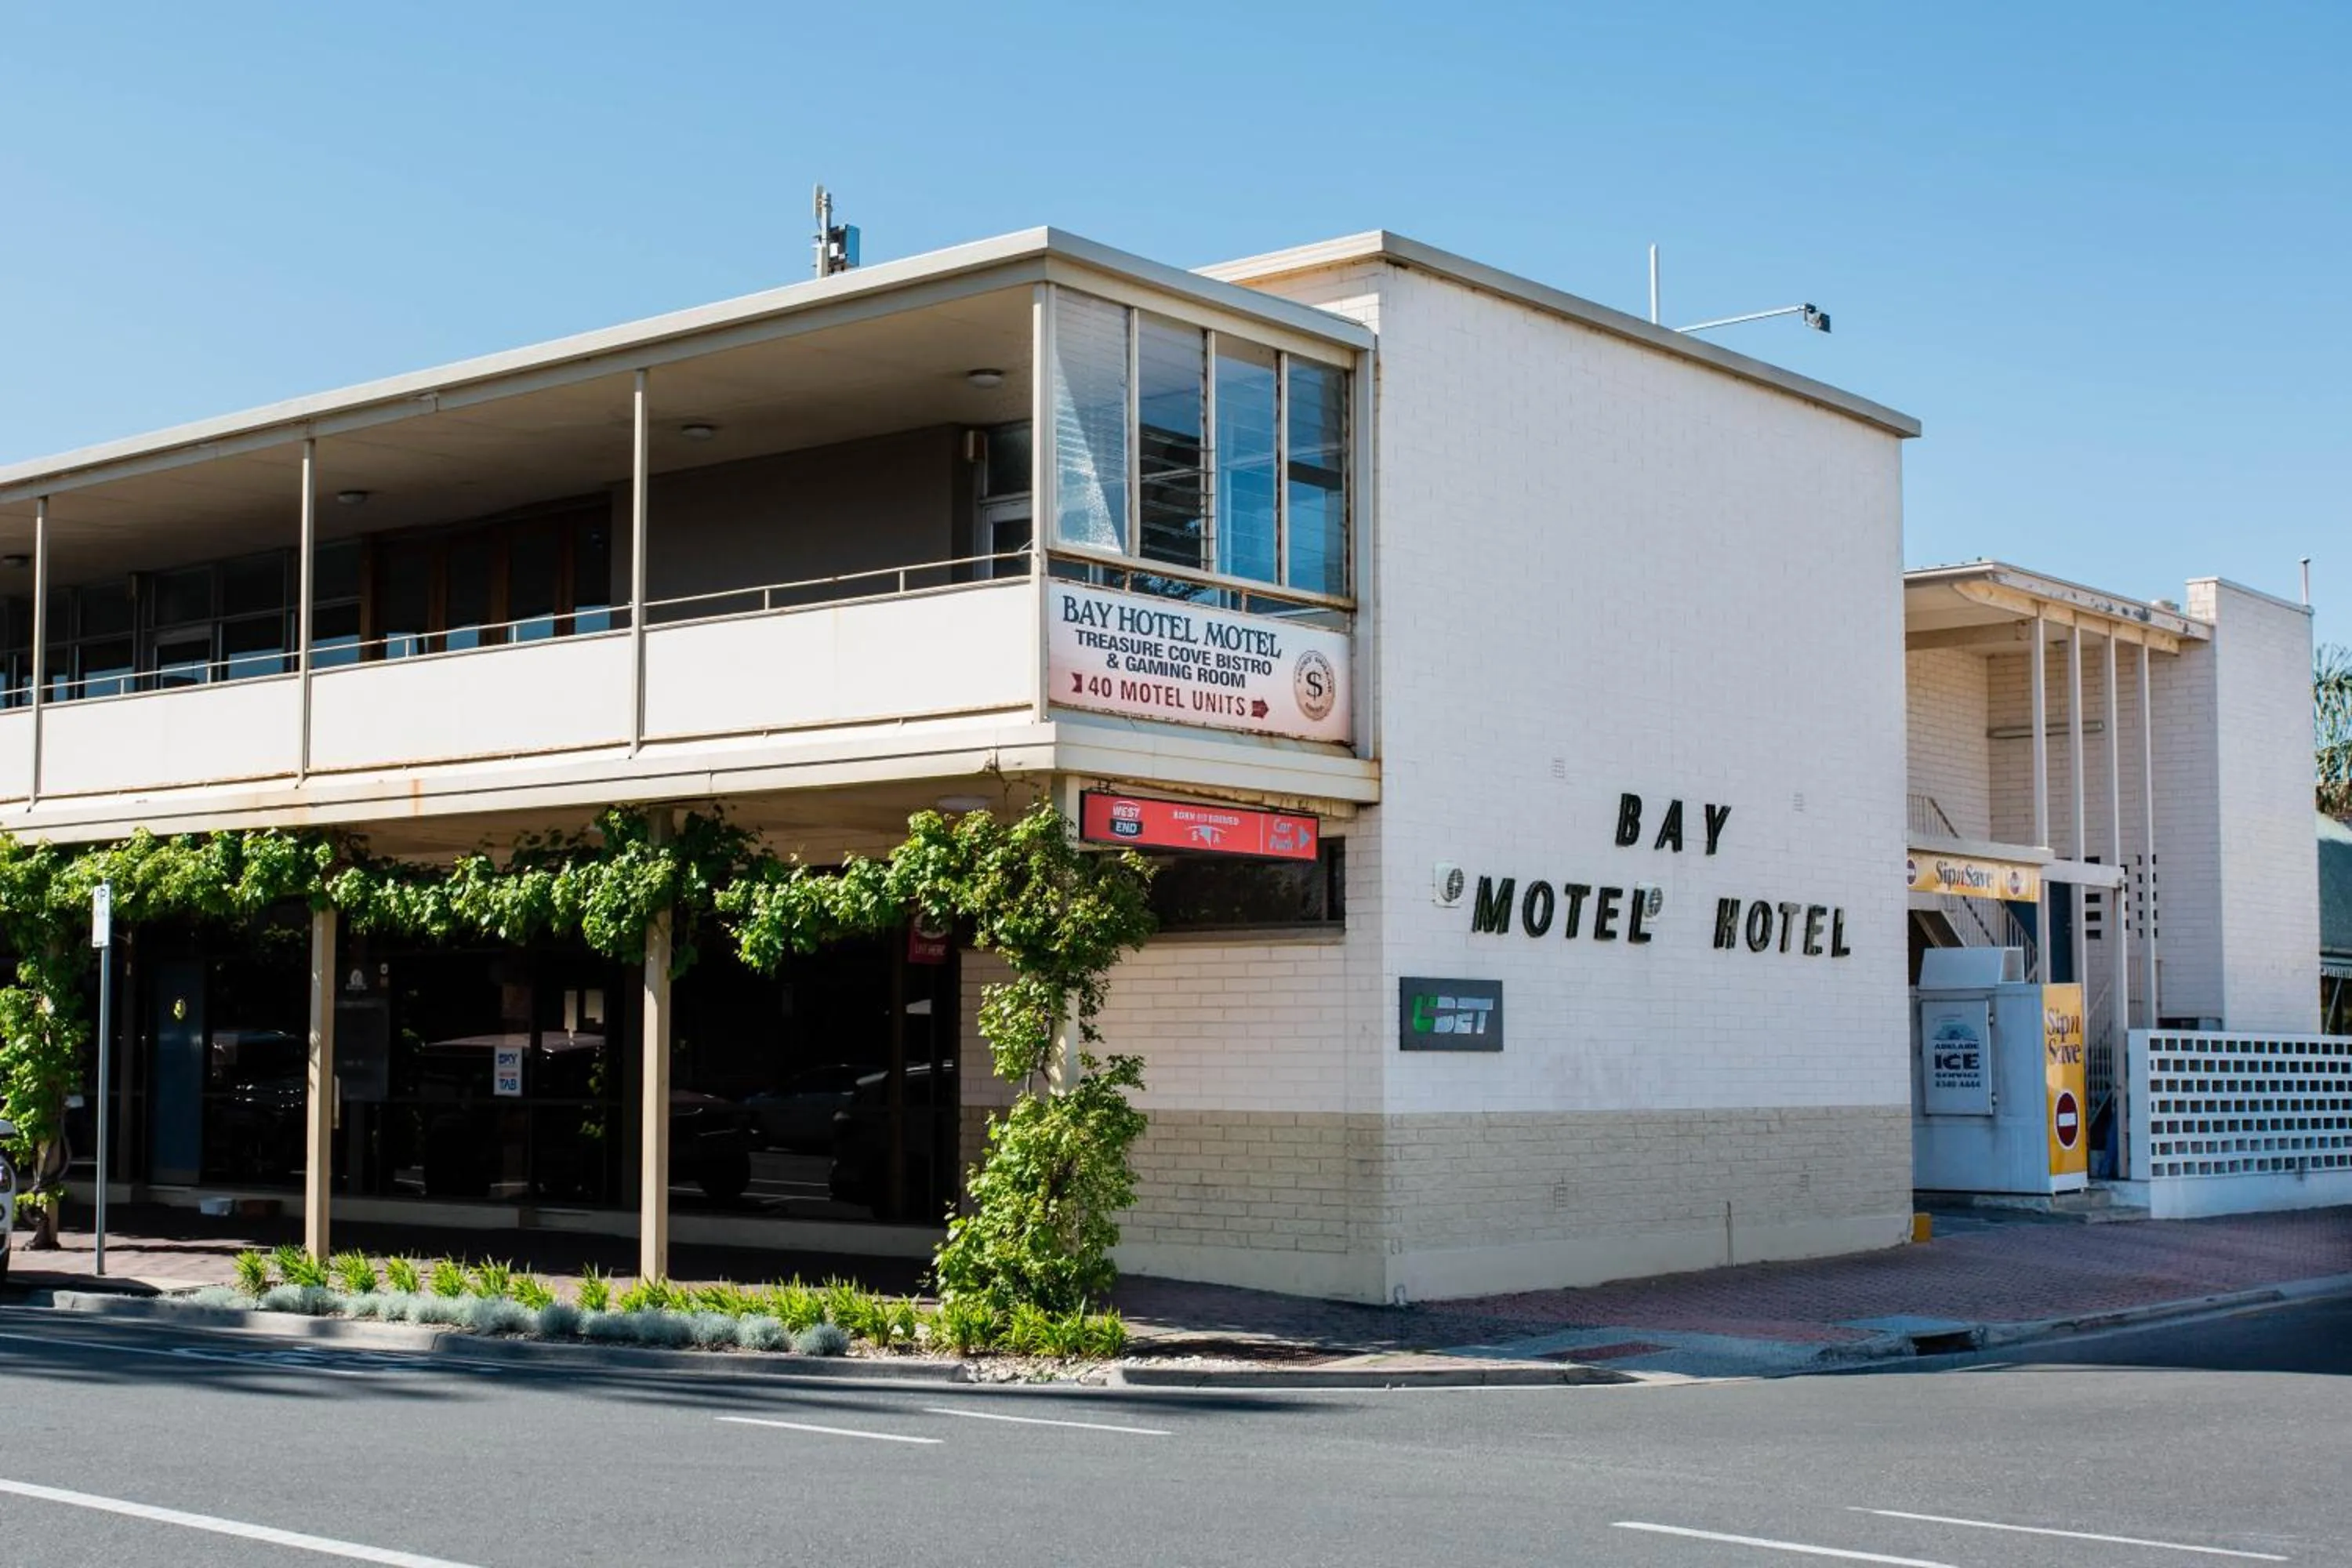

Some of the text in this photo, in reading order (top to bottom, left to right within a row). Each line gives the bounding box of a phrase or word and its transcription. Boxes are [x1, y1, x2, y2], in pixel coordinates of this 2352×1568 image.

[1062, 595, 1282, 659] BAY HOTEL MOTEL
[1075, 629, 1163, 658] TREASURE
[1168, 645, 1211, 666] COVE
[1216, 653, 1272, 675] BISTRO
[1106, 652, 1245, 688] & GAMING ROOM
[1089, 676, 1245, 716] 40 MOTEL UNITS
[1112, 805, 1141, 818] WEST
[1116, 822, 1138, 833] END
[1273, 818, 1292, 833] Car
[1615, 793, 1731, 855] BAY
[1472, 875, 1850, 958] MOTEL HOTEL
[1414, 995, 1494, 1034] UBET
[1934, 1053, 1980, 1069] ICE
[2048, 1037, 2082, 1064] Save
